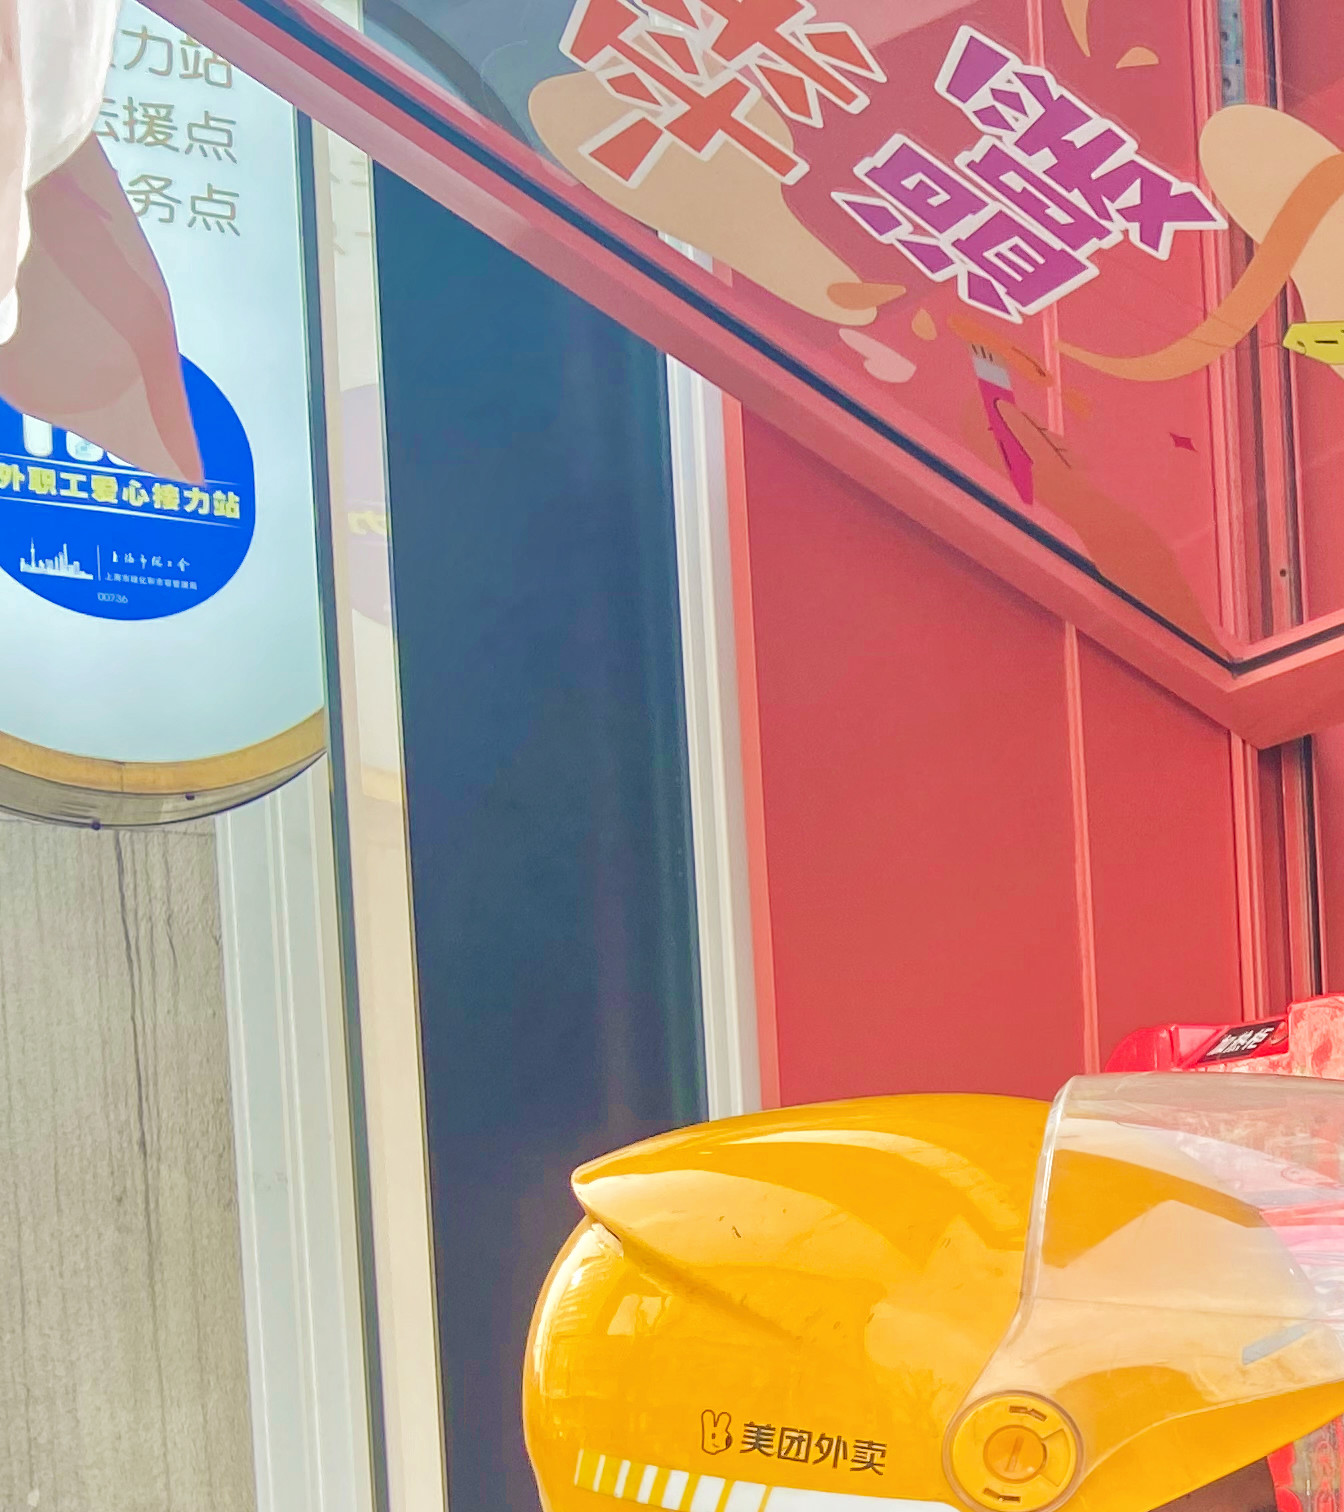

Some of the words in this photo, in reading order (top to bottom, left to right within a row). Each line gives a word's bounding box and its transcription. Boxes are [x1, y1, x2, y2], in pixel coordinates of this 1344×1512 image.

[111, 25, 233, 88] 力站
[832, 25, 1227, 323] 温暖
[739, 1421, 888, 1475] 美团外卖
